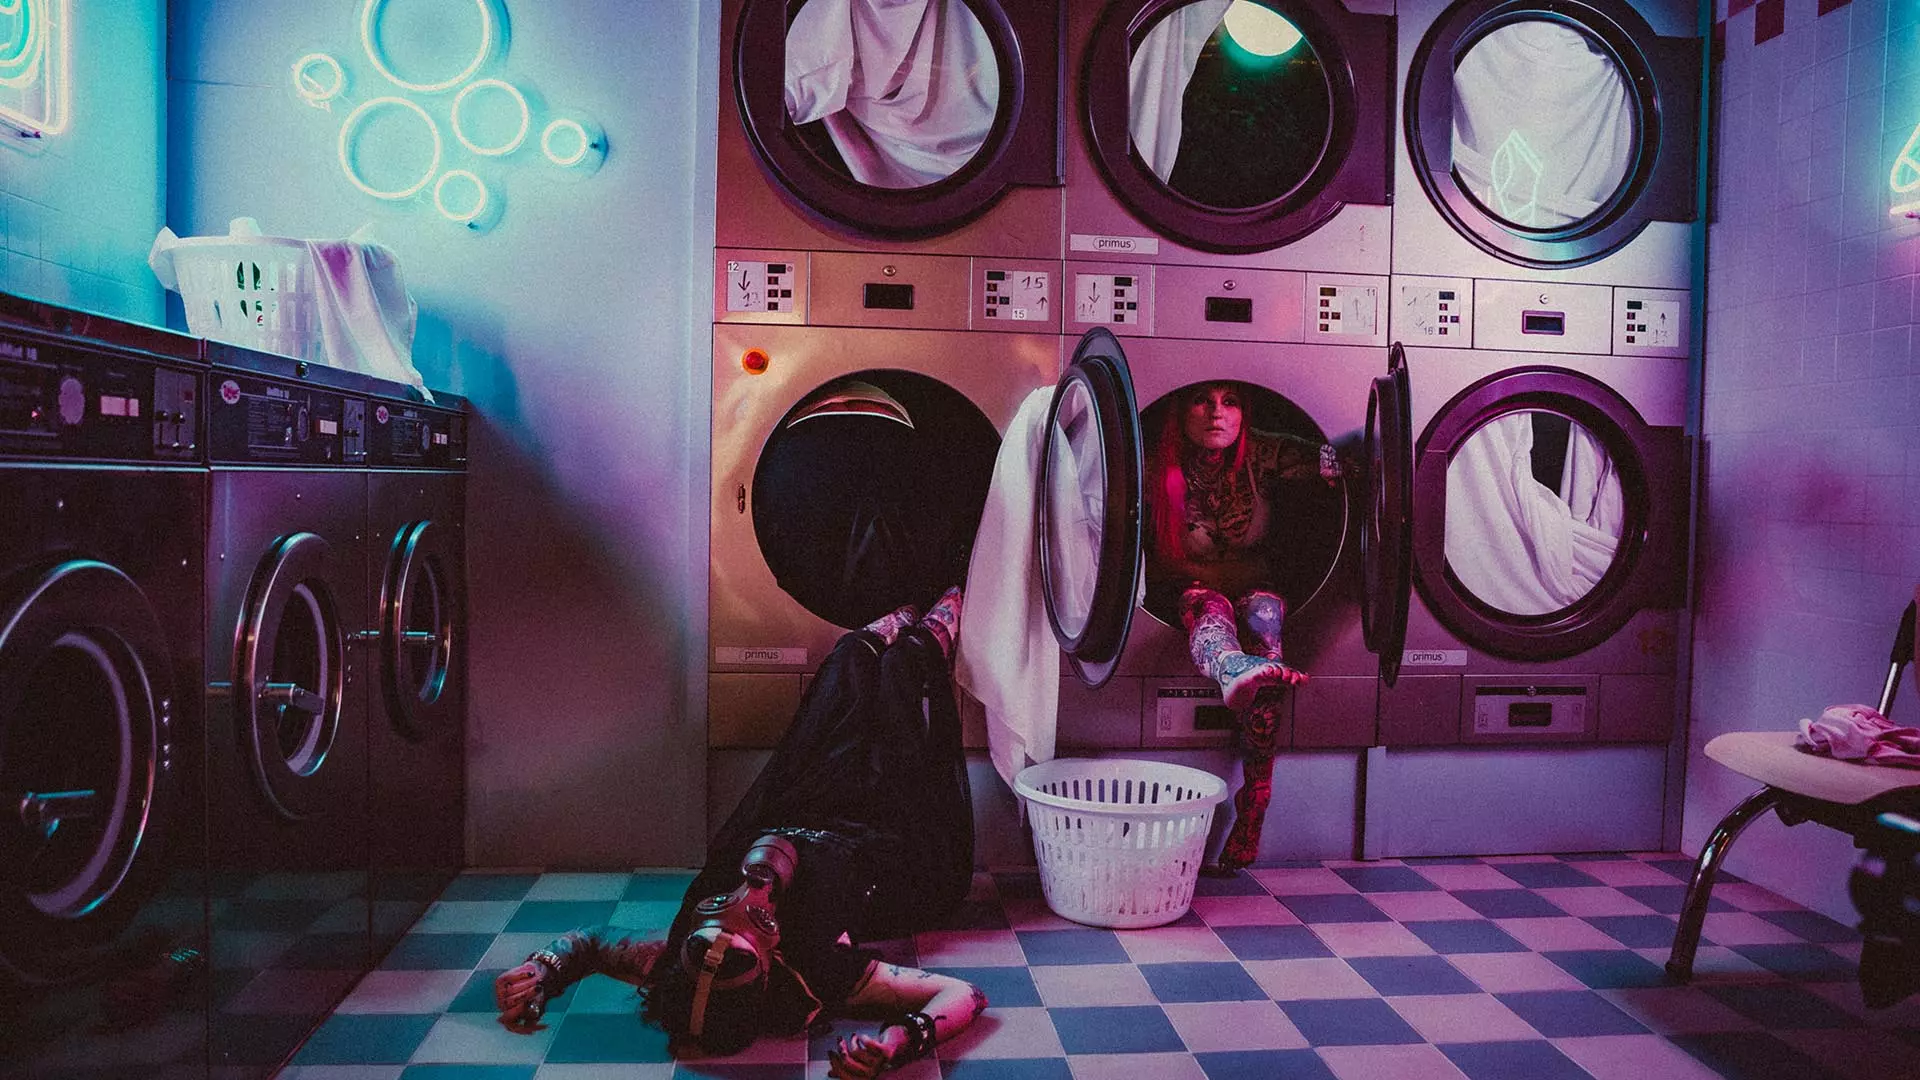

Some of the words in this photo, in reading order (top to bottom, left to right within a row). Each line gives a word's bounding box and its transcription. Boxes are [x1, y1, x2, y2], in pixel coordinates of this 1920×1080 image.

[1098, 239, 1132, 249] primus
[728, 262, 739, 271] 12
[1021, 276, 1046, 291] 15
[1014, 310, 1025, 318] 15
[1424, 327, 1434, 335] 16
[744, 650, 779, 660] primus
[1412, 653, 1442, 662] primus
